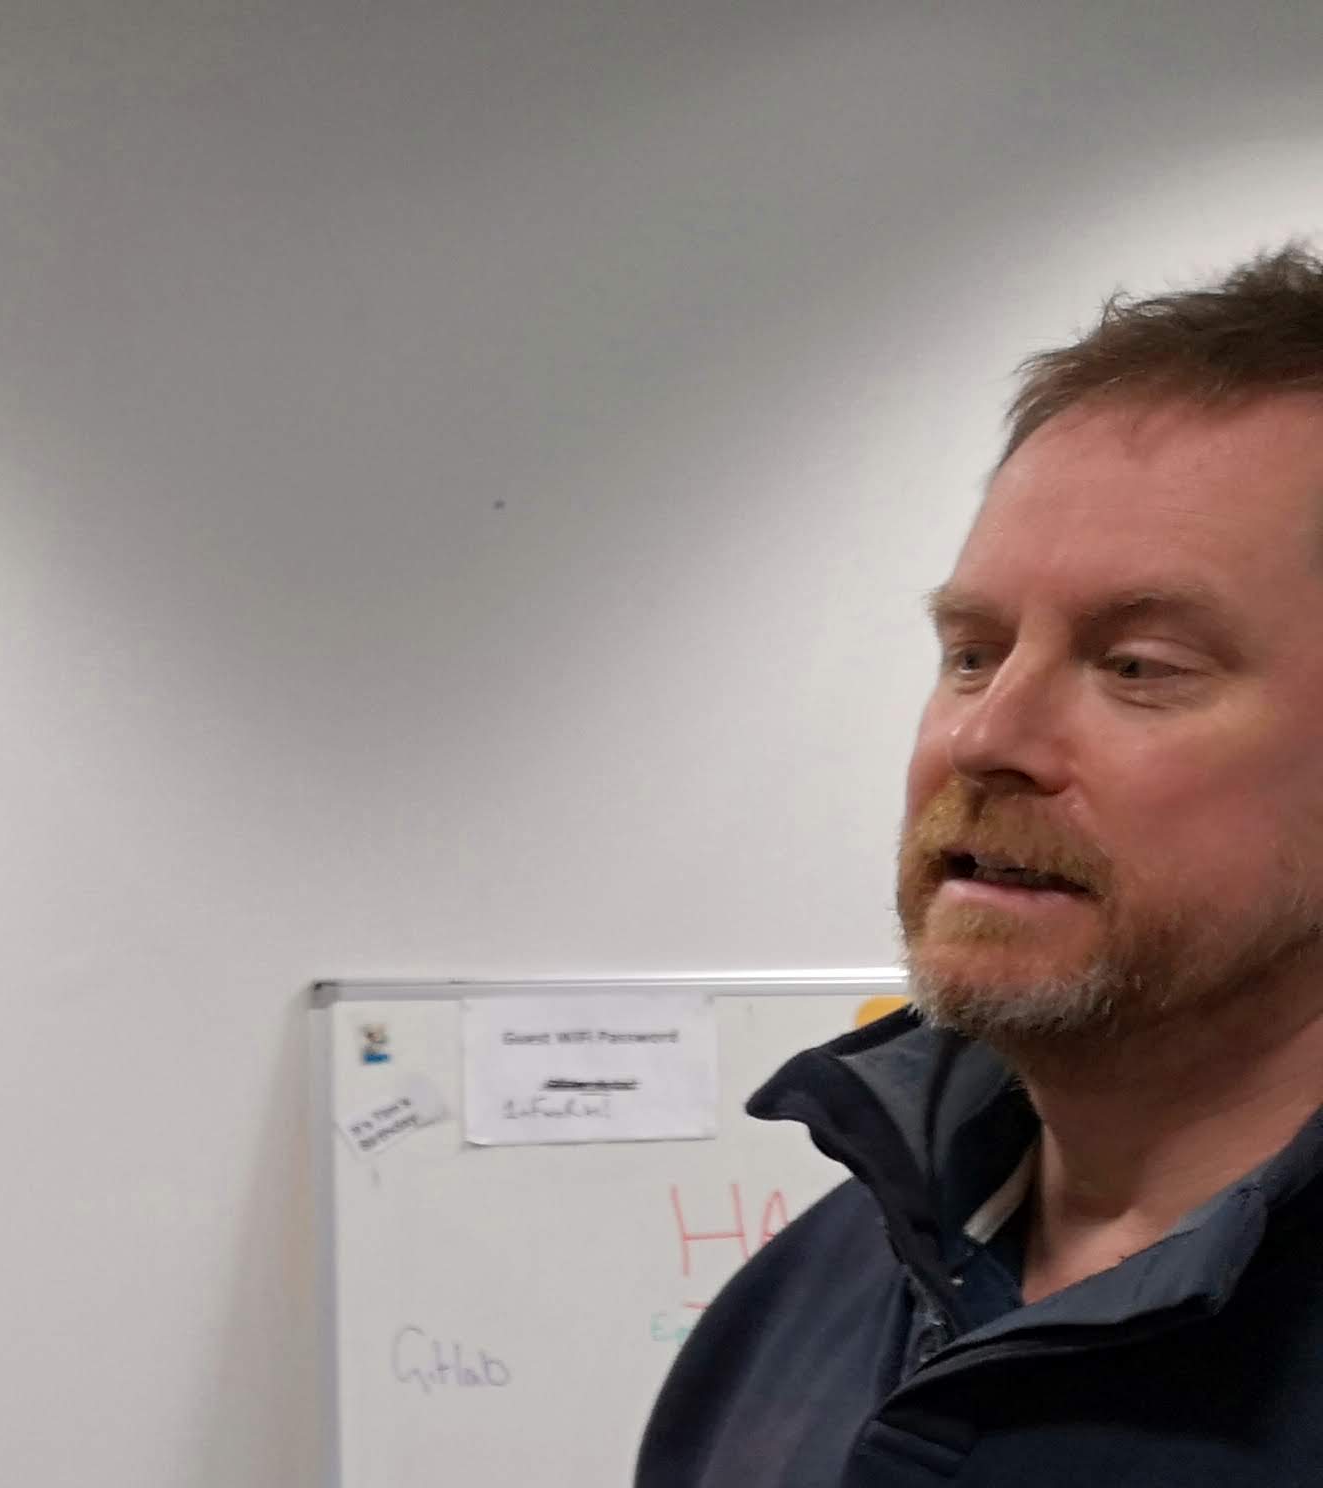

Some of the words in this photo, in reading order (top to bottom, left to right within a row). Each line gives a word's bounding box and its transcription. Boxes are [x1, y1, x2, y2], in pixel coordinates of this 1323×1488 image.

[502, 1031, 551, 1046] Guest
[598, 1030, 679, 1045] Password
[669, 1182, 793, 1278] HA
